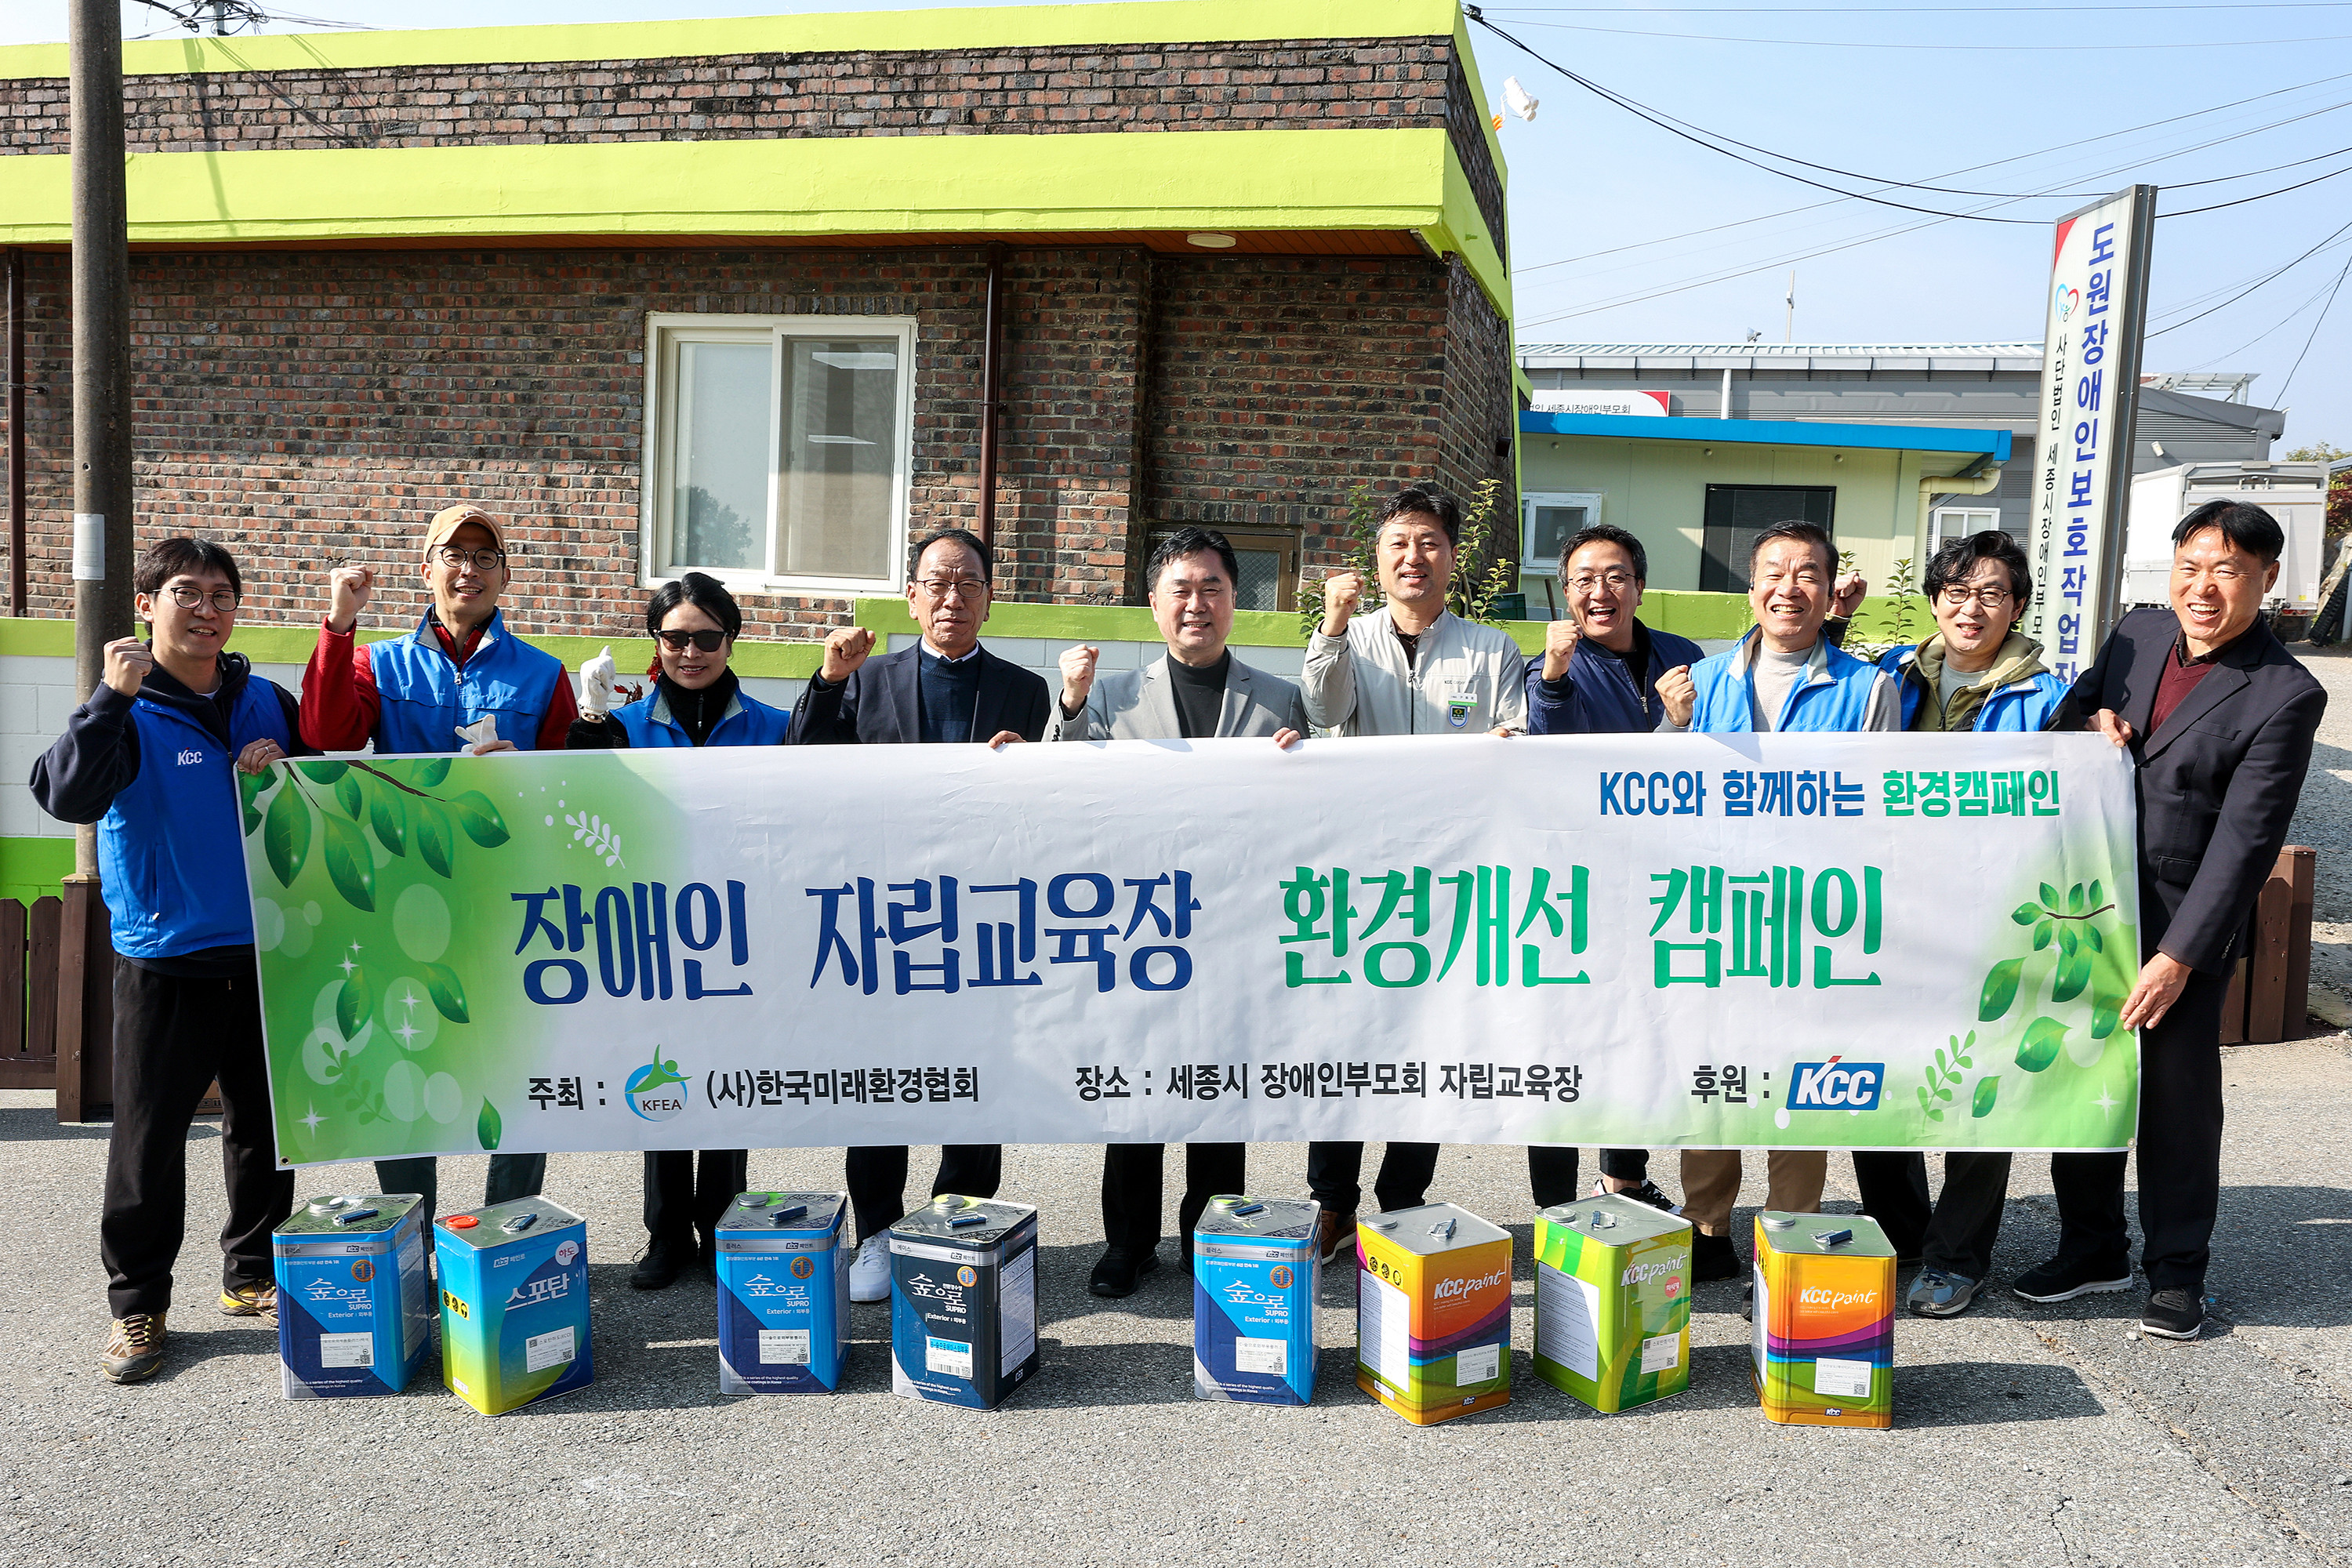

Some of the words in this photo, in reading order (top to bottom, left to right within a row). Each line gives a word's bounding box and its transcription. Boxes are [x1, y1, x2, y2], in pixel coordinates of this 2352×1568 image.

[2050, 332, 2067, 431] 사단법인
[1547, 404, 1631, 414] 세종시장애인부모회
[2032, 442, 2058, 643] 세종시장애인부모
[177, 747, 202, 766] KCC
[1602, 772, 1707, 817] KCC와
[1724, 771, 1865, 818] 함께하는
[1884, 771, 2060, 818] 환경캠페인
[510, 880, 753, 1005] 장애인
[804, 869, 1202, 996] 자립교육장
[1279, 866, 1592, 989] 환경개선
[1649, 866, 1883, 989] 캠페인
[528, 1076, 585, 1112] 주최
[706, 1067, 980, 1110] (사)한국미래환경협회
[1075, 1065, 1132, 1102] 장소
[1167, 1063, 1249, 1102] 세종시
[1261, 1062, 1427, 1100] 장애인부모회
[1439, 1063, 1584, 1104] 자립교육장
[1691, 1065, 1748, 1105] 후원
[1795, 1055, 1876, 1105] KCC
[642, 1099, 682, 1111] KFEA
[494, 1257, 509, 1267] KCC
[510, 1253, 526, 1262] 페인트
[559, 1247, 575, 1257] 하도
[1434, 1278, 1464, 1300] KCC
[1463, 1269, 1506, 1299] paint
[1621, 1262, 1649, 1287] KCC
[1648, 1252, 1688, 1285] paint
[304, 1278, 372, 1304] 숲으로
[504, 1272, 571, 1312] 스포탄
[744, 1274, 809, 1300] 숲으로
[907, 1272, 967, 1307] 숲으로
[1223, 1280, 1289, 1310] 숲으로
[1800, 1286, 1832, 1304] KCC
[1831, 1289, 1877, 1309] paint
[927, 1313, 950, 1321] Exterior
[945, 1305, 966, 1314] SUPRO
